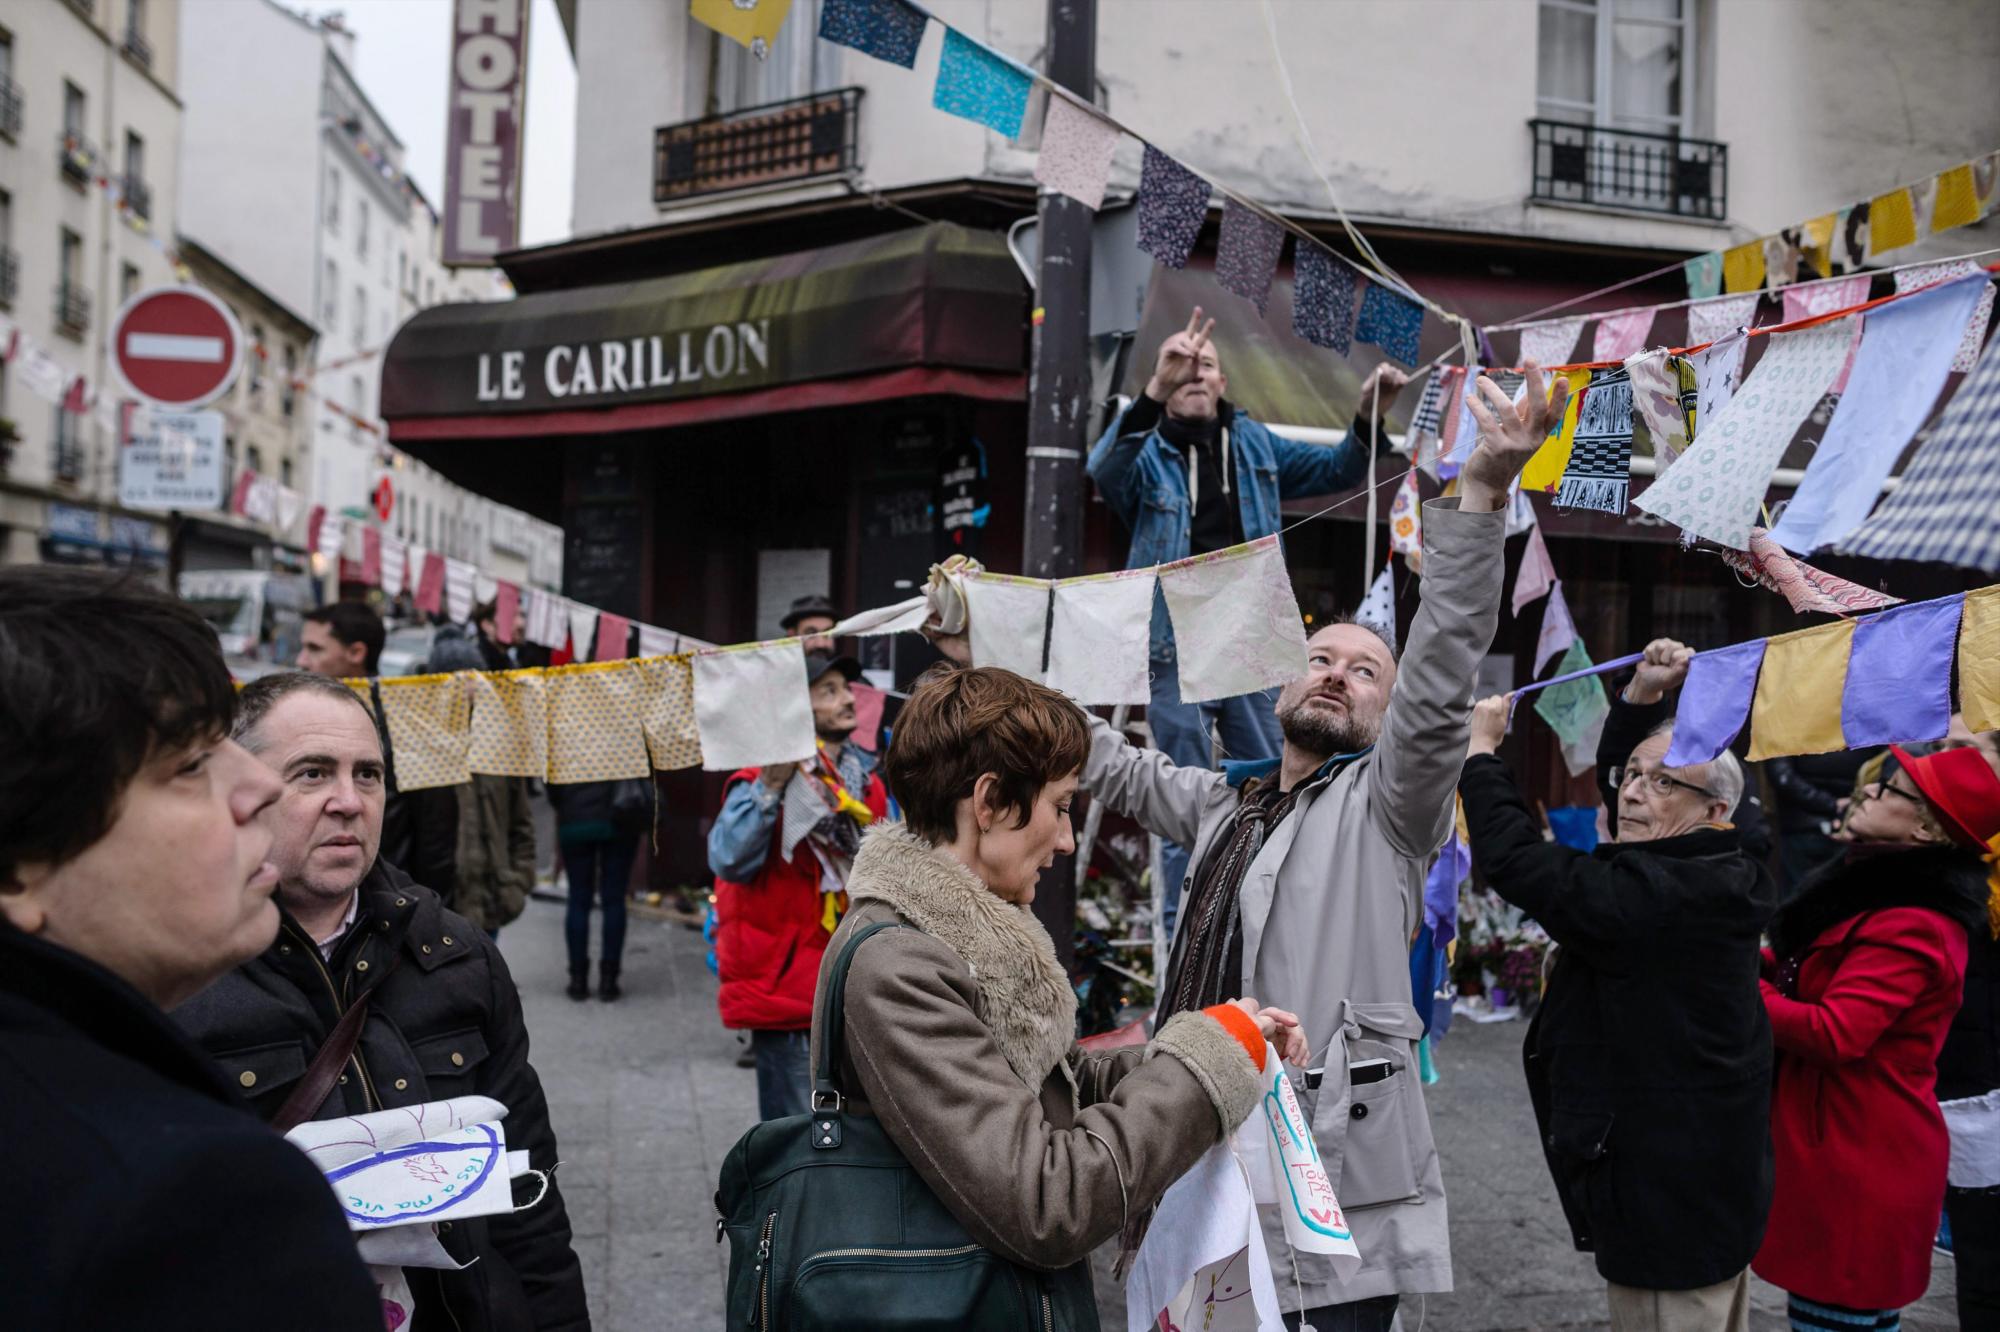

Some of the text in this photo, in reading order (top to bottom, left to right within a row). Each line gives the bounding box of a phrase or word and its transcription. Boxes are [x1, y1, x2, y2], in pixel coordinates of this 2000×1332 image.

[457, 0, 518, 254] HOTEL
[477, 319, 769, 401] LE CARILLON
[1282, 1078, 1305, 1137] musique
[1273, 1109, 1290, 1148] Rire
[457, 1157, 484, 1181] Pas
[348, 1196, 384, 1214] vie
[395, 1195, 433, 1208] ma
[1308, 1208, 1348, 1229] VI
